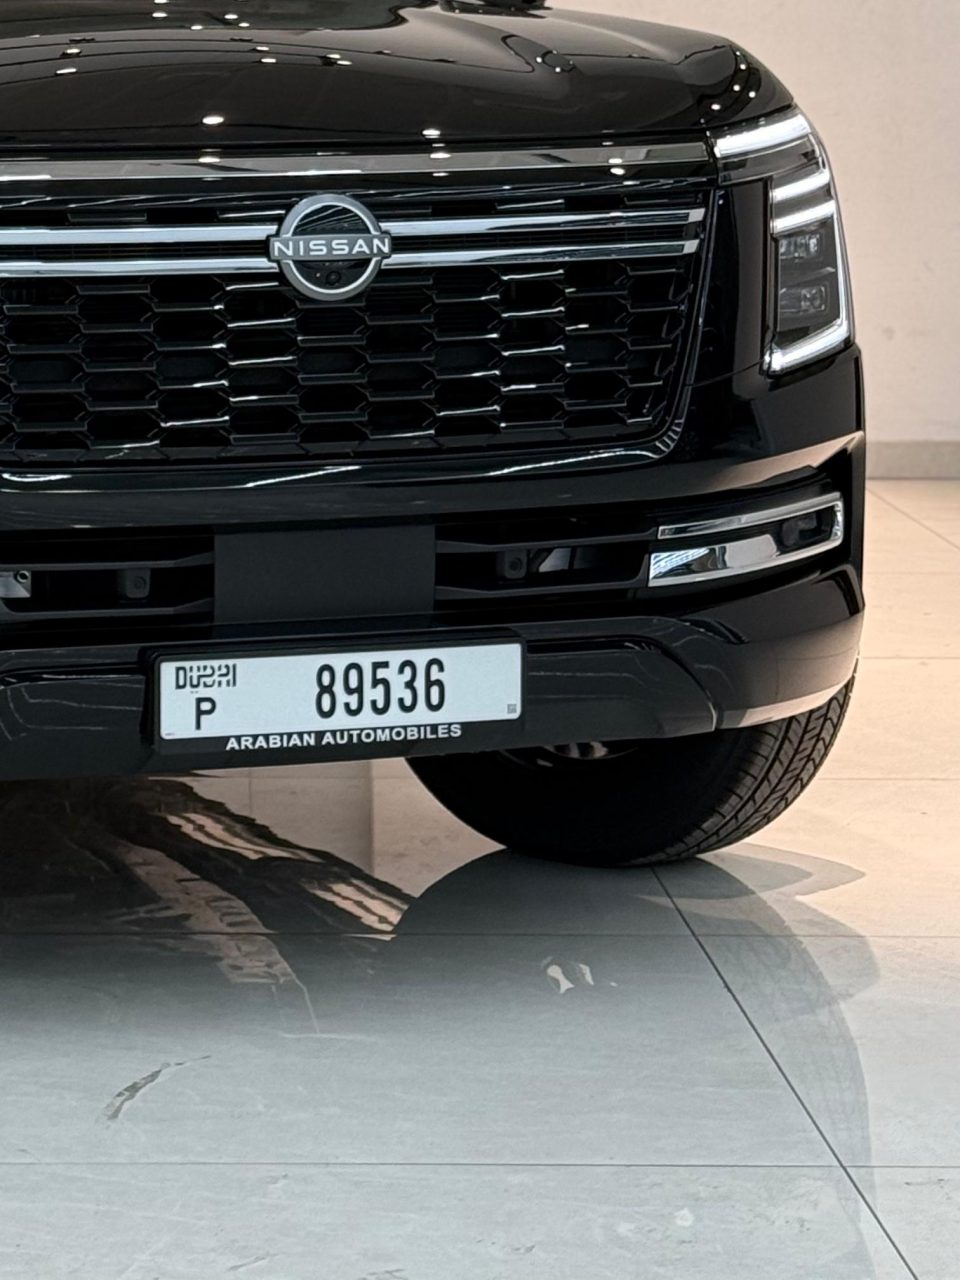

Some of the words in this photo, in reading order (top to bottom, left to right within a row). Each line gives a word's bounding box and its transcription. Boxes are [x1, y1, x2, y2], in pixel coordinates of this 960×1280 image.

[273, 238, 389, 257] NISSAN
[315, 658, 445, 719] 89536
[195, 697, 216, 730] P
[225, 732, 316, 751] ARABIAN
[321, 724, 462, 745] AUTOMOBILES
